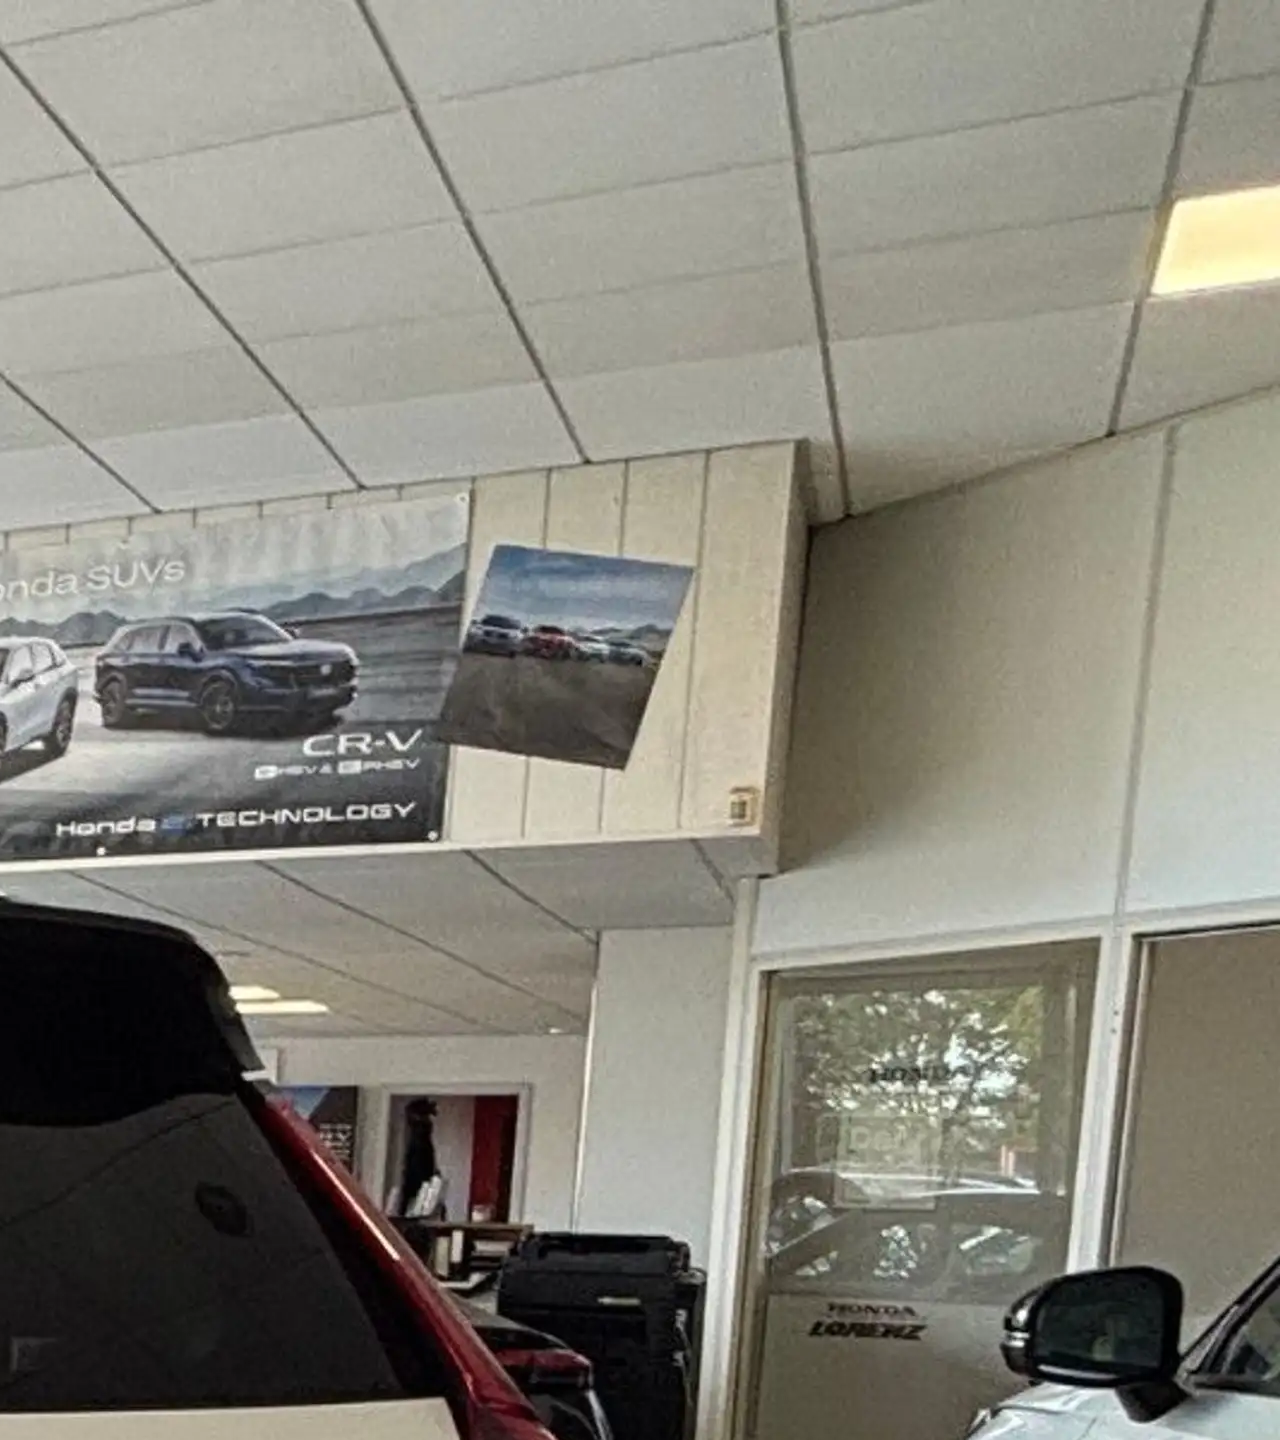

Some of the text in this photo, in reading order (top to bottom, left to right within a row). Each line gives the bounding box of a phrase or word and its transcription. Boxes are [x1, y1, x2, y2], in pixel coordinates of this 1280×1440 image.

[86, 556, 186, 593] SUVs
[302, 728, 424, 757] CR-V
[56, 815, 157, 837] Honda
